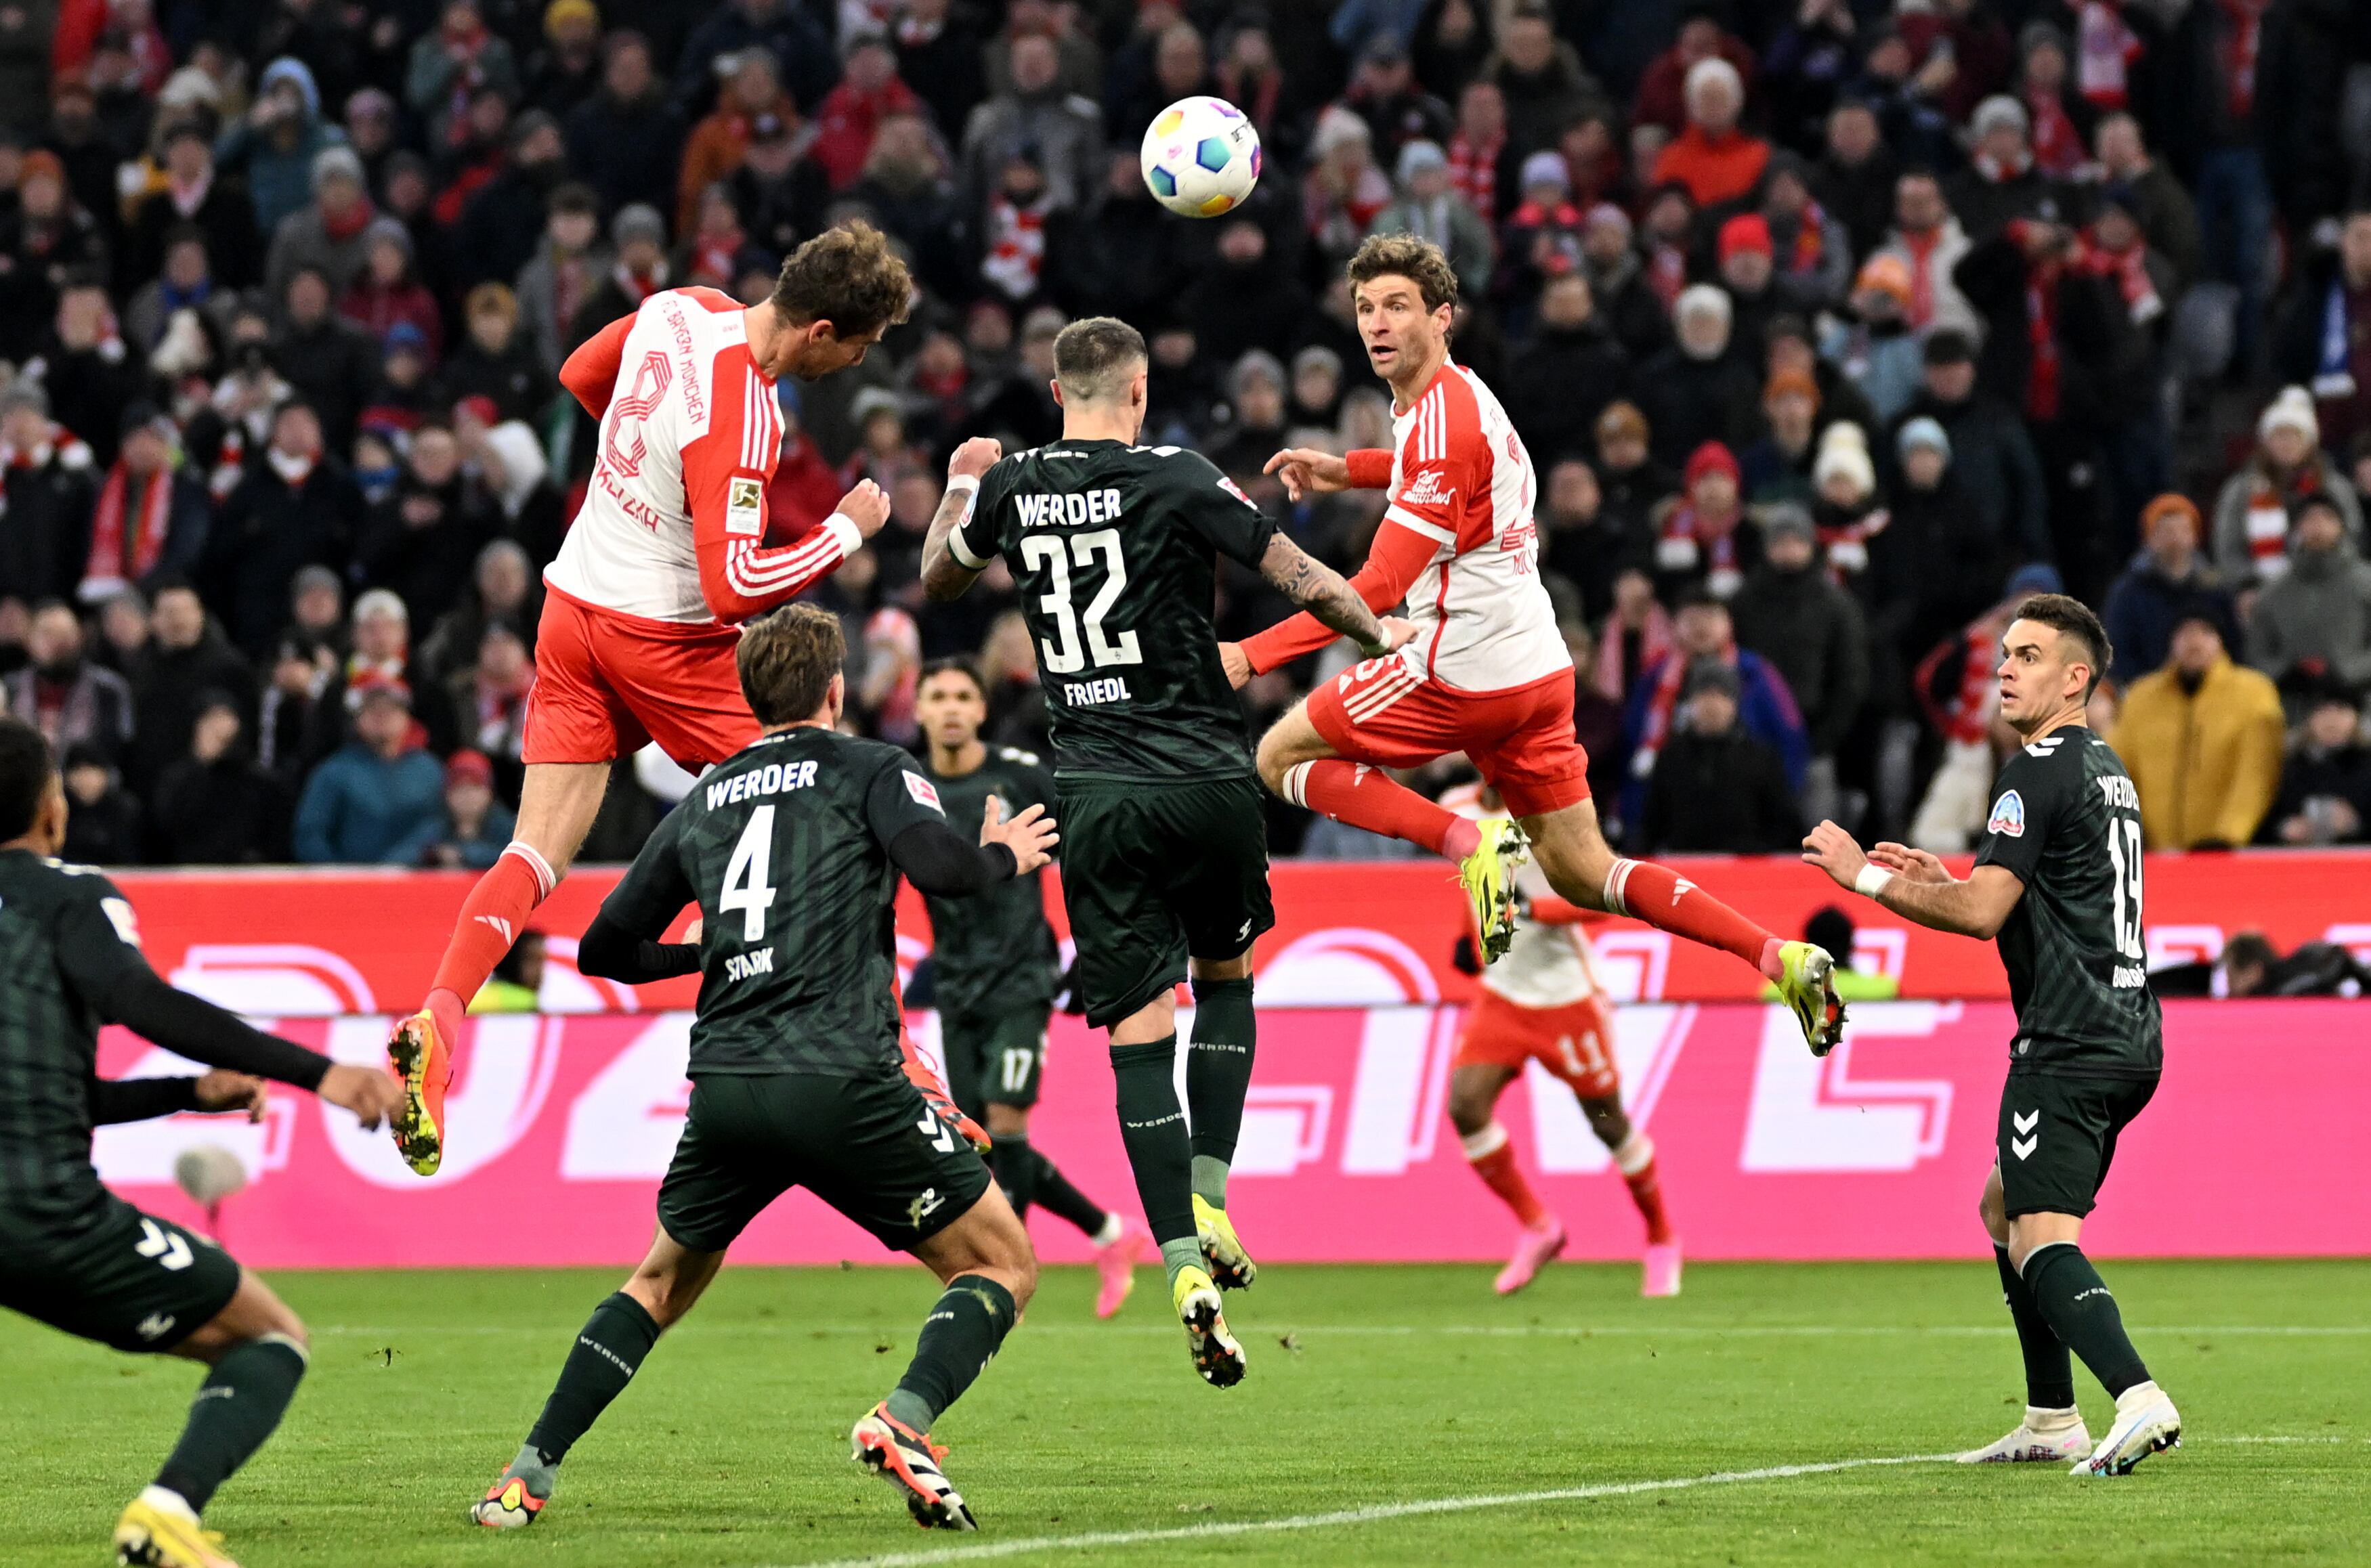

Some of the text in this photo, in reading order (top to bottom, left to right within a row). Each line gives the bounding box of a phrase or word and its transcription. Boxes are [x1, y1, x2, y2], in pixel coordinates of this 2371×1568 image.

[667, 310, 694, 356] BAYERN
[606, 350, 673, 478] 8
[1014, 488, 1122, 527] WERDER
[1020, 528, 1143, 674] 32
[1064, 677, 1132, 707] FRIEDL
[706, 760, 819, 812] WERDER
[2097, 775, 2140, 812] WERDE
[719, 804, 777, 942] 4
[2107, 816, 2144, 959] 19
[724, 947, 774, 982] STARK
[1001, 1047, 1033, 1092] 17
[1559, 1030, 1606, 1076] 11
[580, 1335, 633, 1378] WERDER
